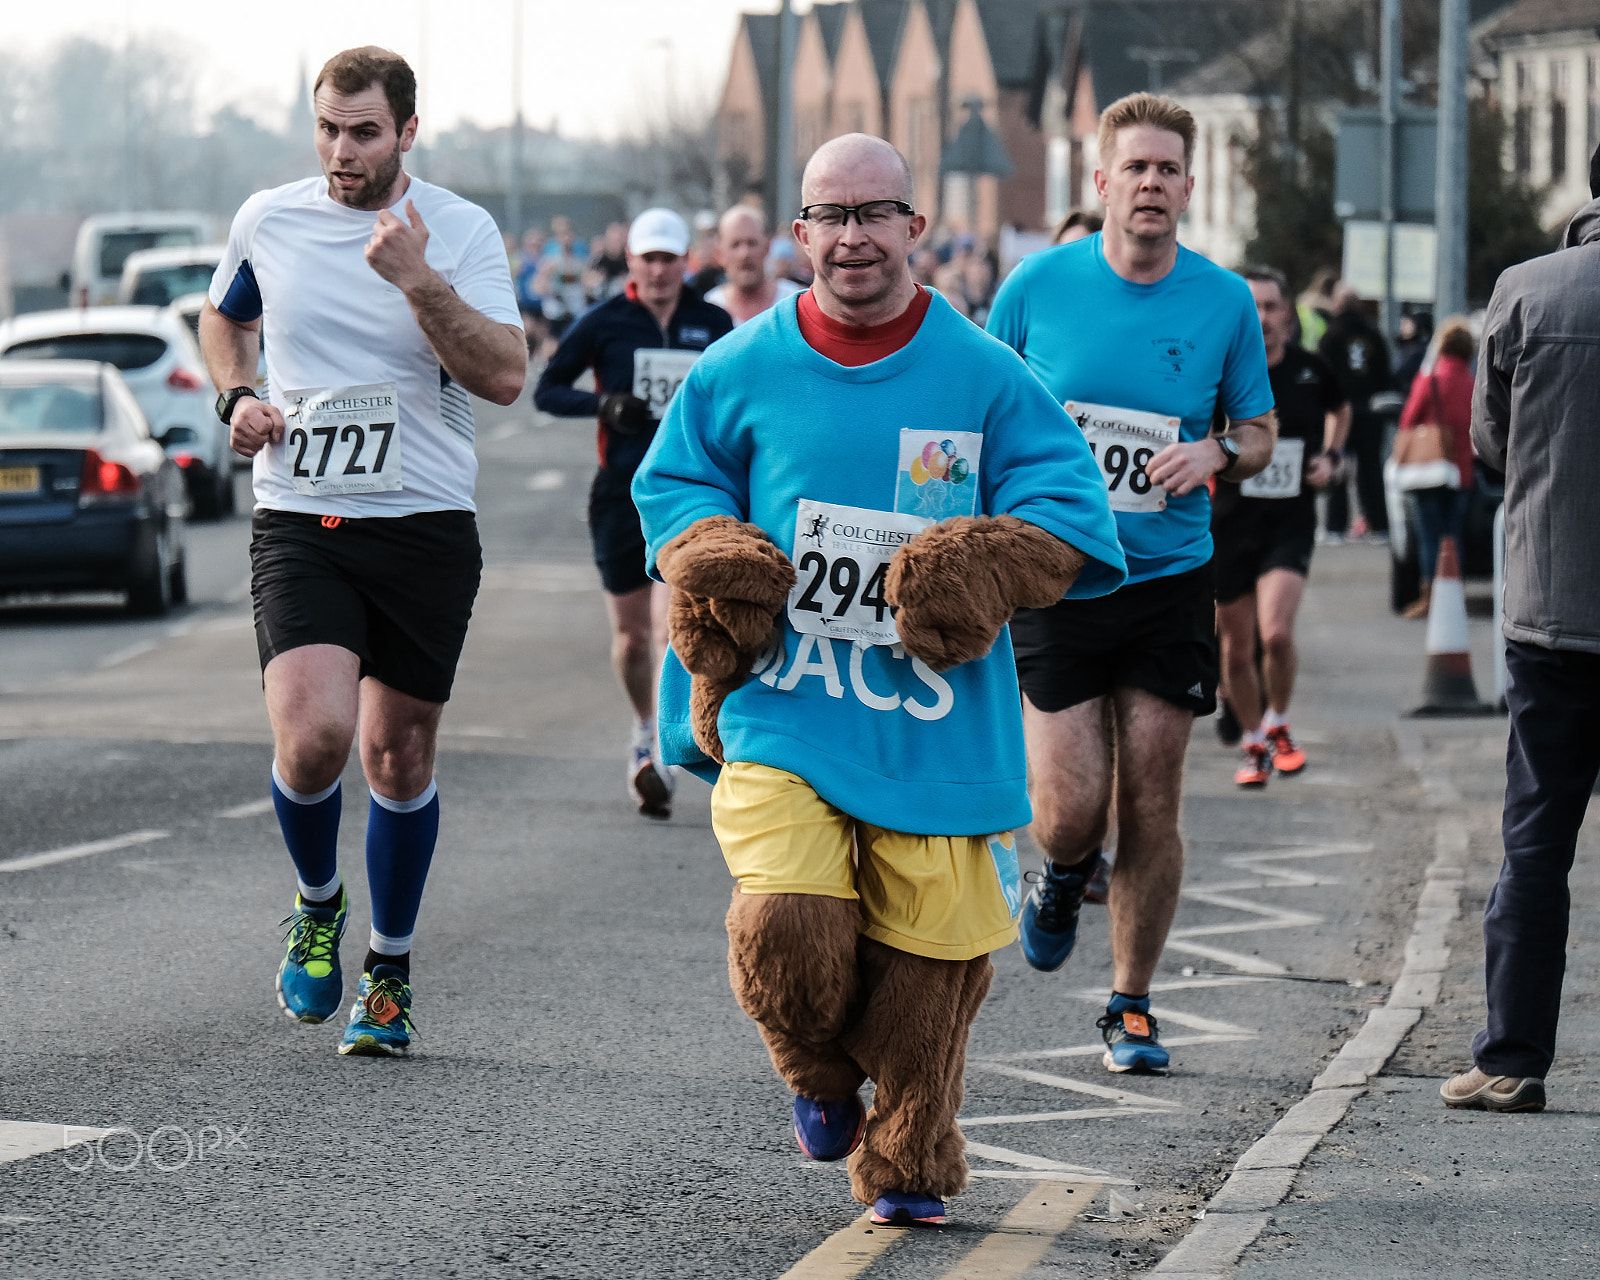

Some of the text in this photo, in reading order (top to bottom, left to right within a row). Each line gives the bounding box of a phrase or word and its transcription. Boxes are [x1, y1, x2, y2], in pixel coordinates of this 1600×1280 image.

[640, 377, 683, 406] 33
[308, 396, 393, 411] COLCHESTER
[1093, 419, 1174, 440] COLCHESTER
[289, 422, 396, 478] 2727
[832, 523, 913, 545] COLCHEST
[832, 541, 861, 553] HALF
[794, 551, 900, 622] 294
